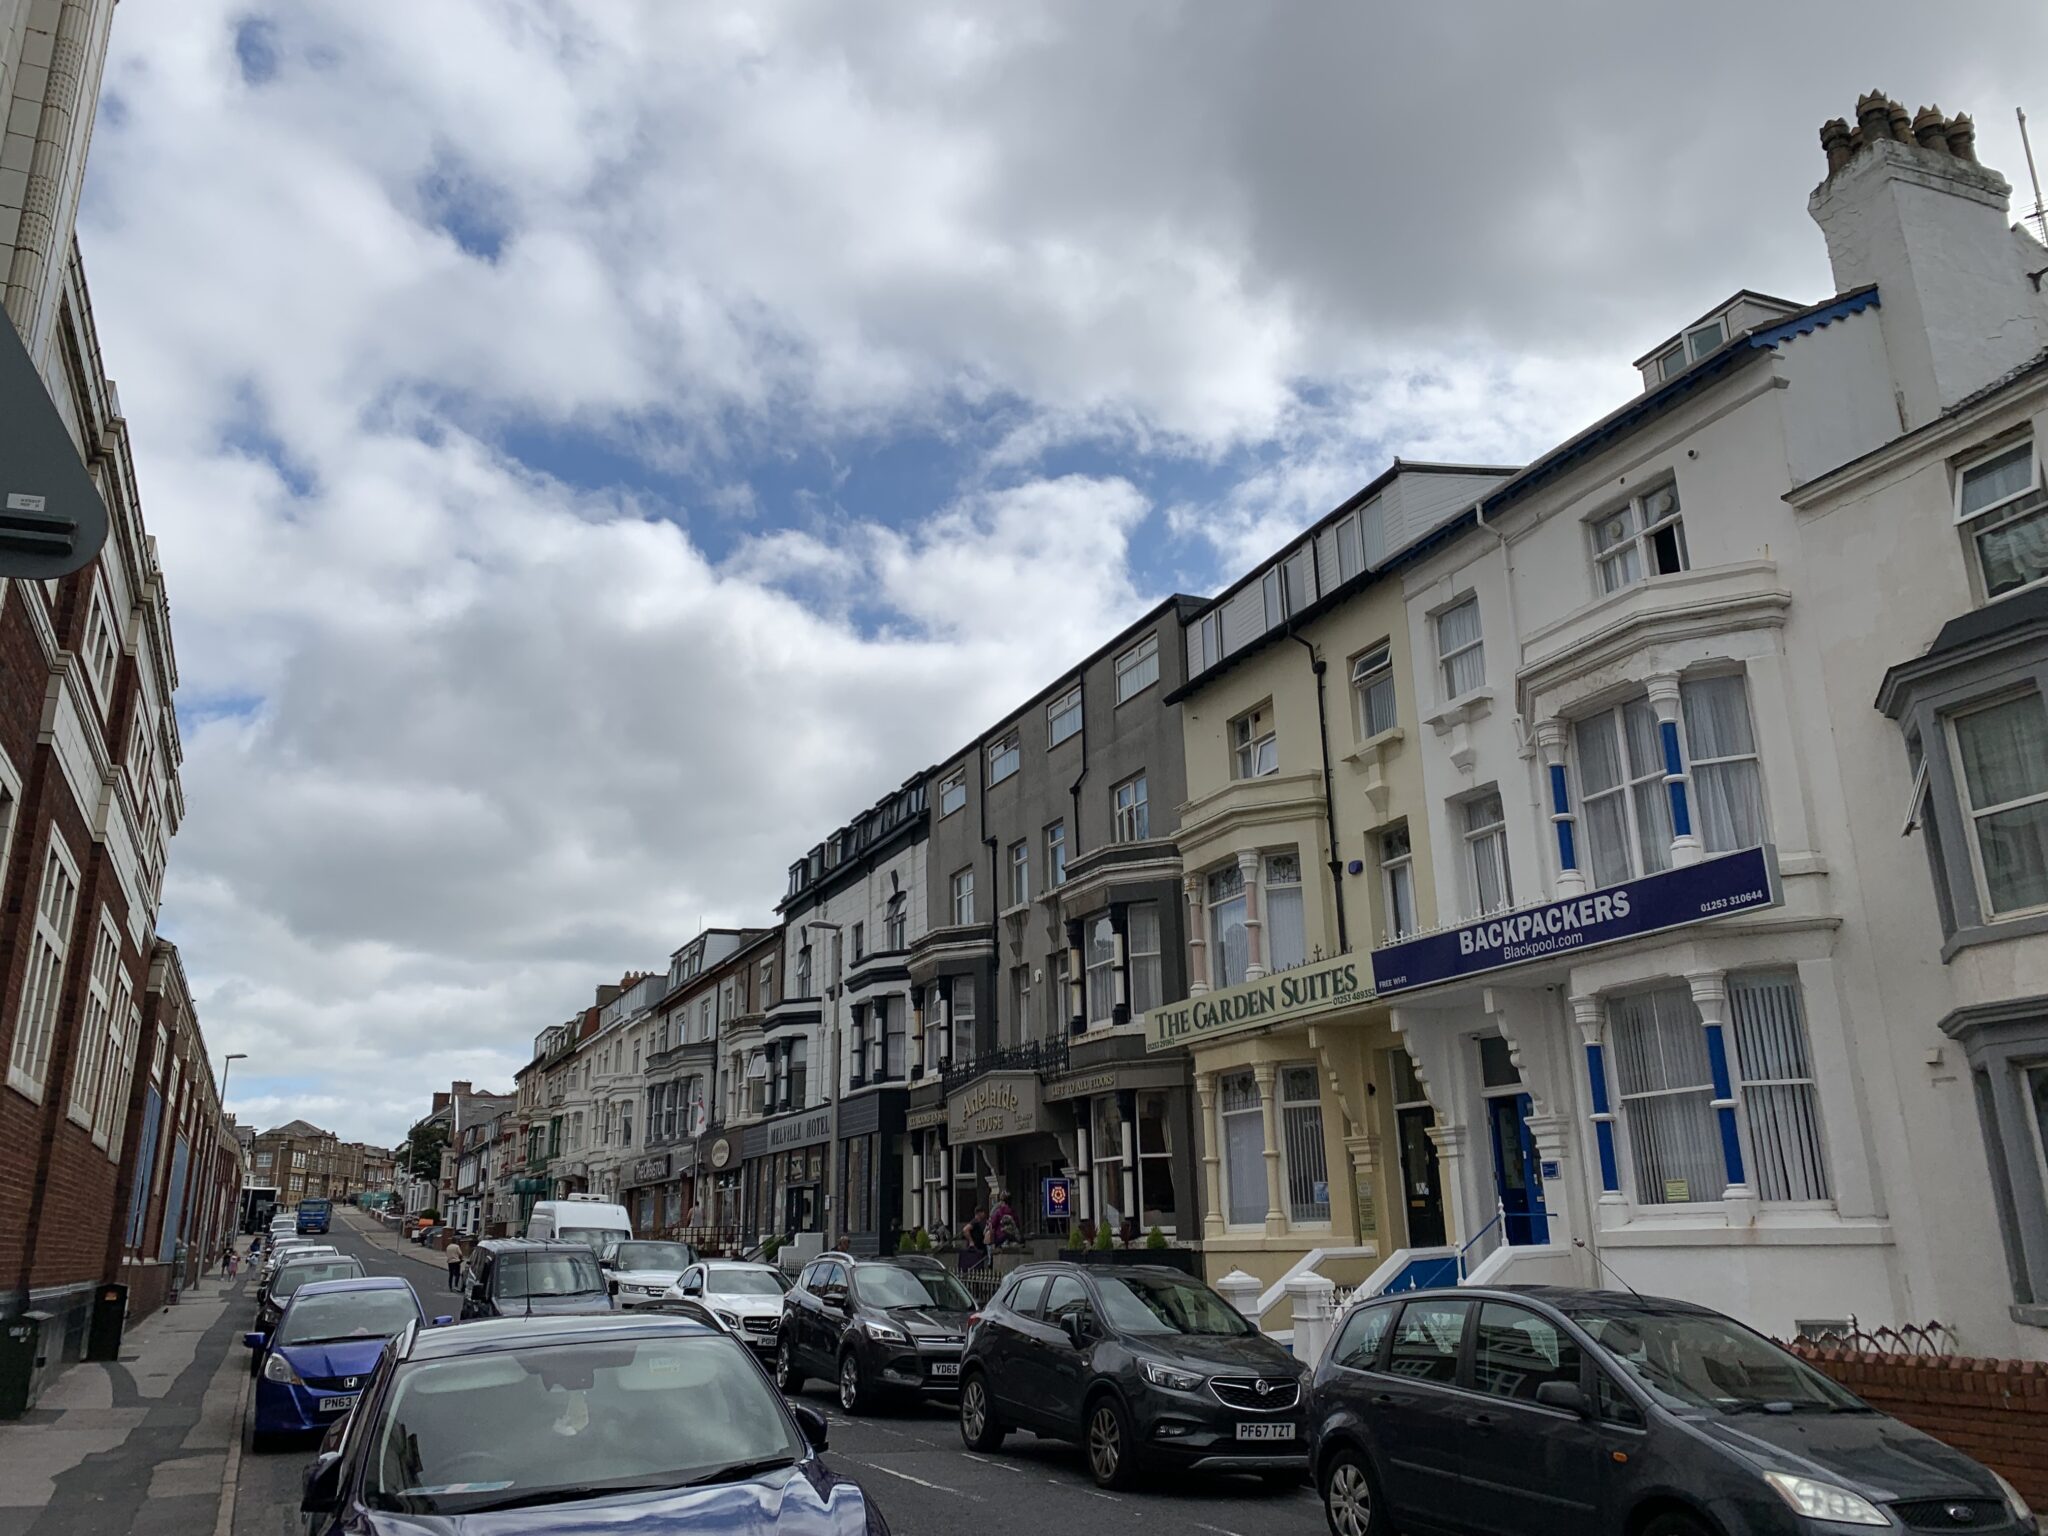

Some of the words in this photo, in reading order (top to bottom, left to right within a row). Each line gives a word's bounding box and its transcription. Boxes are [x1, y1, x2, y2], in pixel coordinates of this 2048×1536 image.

[1700, 898, 1728, 912] 01253
[1729, 889, 1763, 906] 310644
[1459, 890, 1631, 956] BACKPACKERS
[1503, 931, 1583, 960] Blackpool.com
[1379, 979, 1393, 989] FREE
[1155, 1008, 1190, 1039] THE
[1192, 985, 1276, 1030] GARDEN
[1280, 963, 1358, 1009] SUITES
[1333, 993, 1351, 1006] 01253
[963, 1081, 1019, 1122] Adelaide
[770, 1121, 802, 1145] MELVILLE
[806, 1115, 830, 1138] HOTEL
[976, 1114, 1004, 1133] HOUSE
[936, 1364, 958, 1374] YD65
[324, 1397, 352, 1409] PN63
[1240, 1424, 1269, 1437] PF67
[1272, 1424, 1291, 1437] TZT
